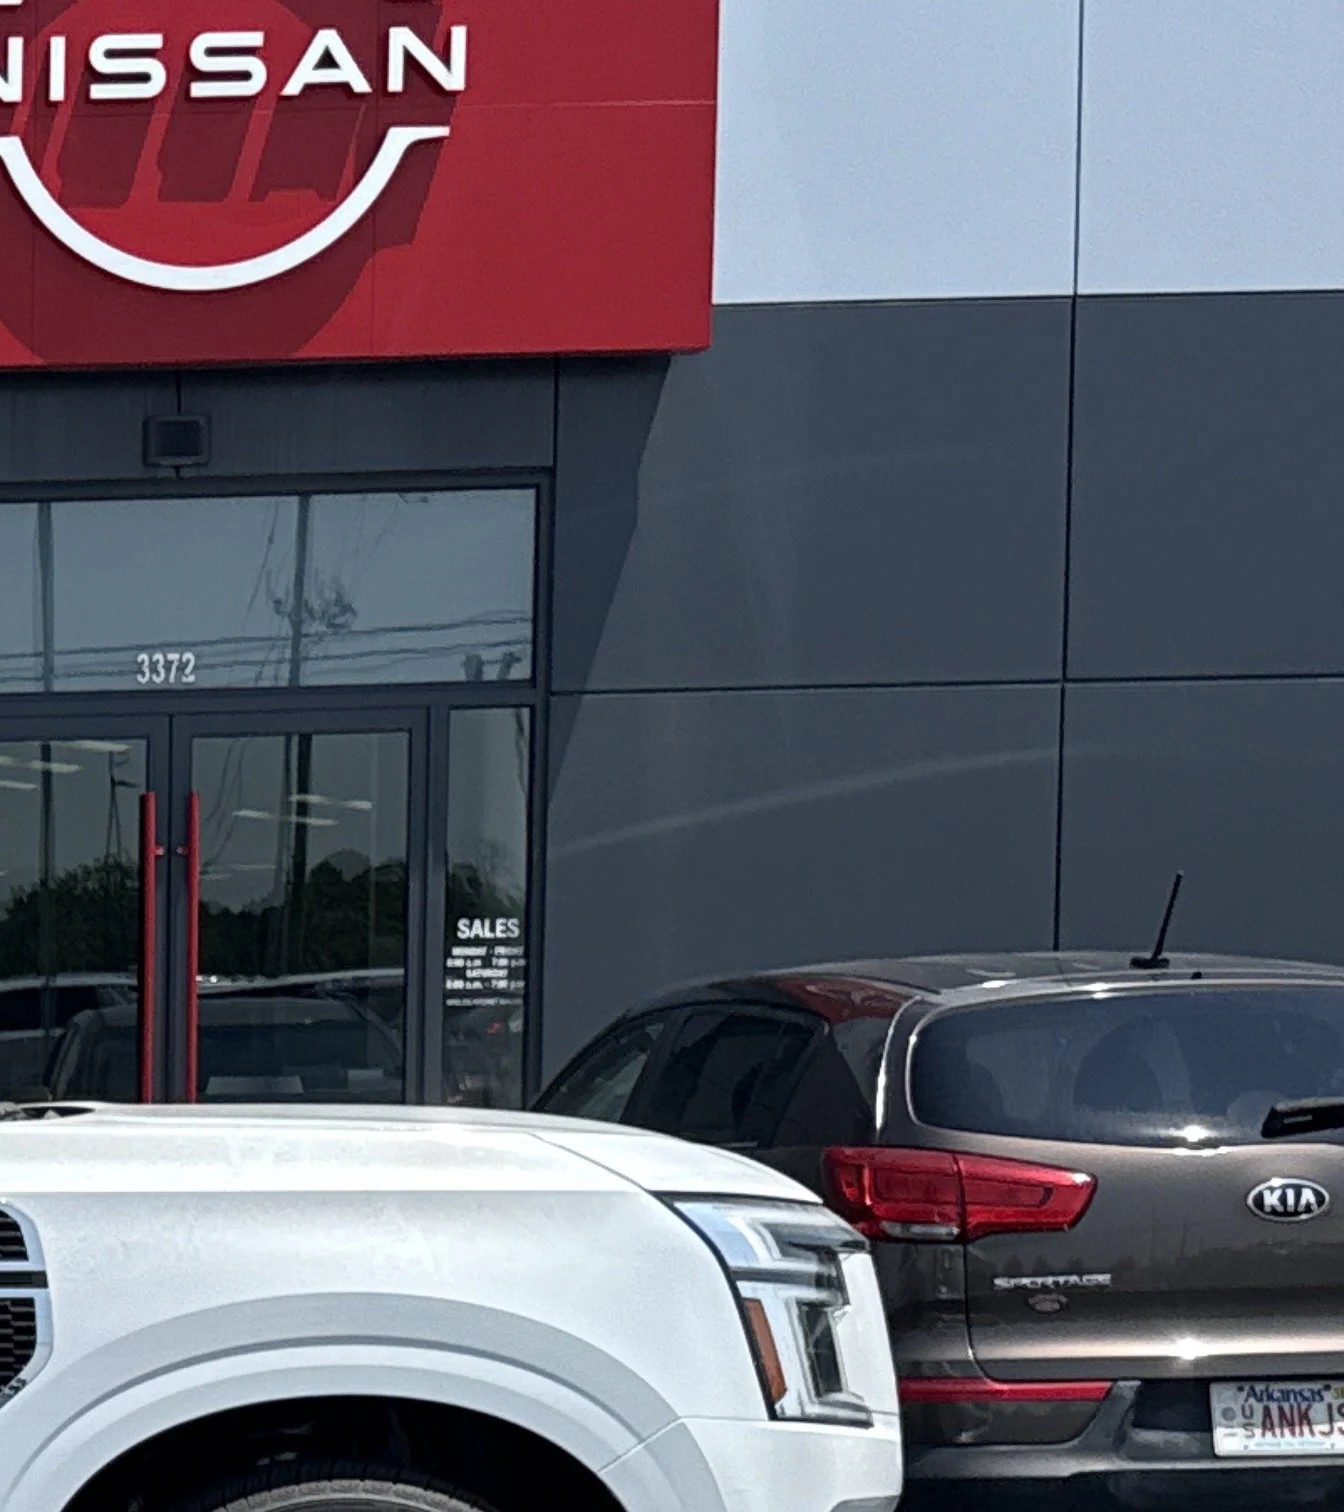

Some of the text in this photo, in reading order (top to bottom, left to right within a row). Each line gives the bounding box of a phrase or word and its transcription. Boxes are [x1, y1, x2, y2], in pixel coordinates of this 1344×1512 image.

[136, 651, 196, 684] 3372
[456, 917, 521, 939] SALES
[1262, 1187, 1318, 1213] KIA
[993, 1273, 1112, 1290] SPORTAGE
[1244, 1384, 1325, 1404] Arkansas
